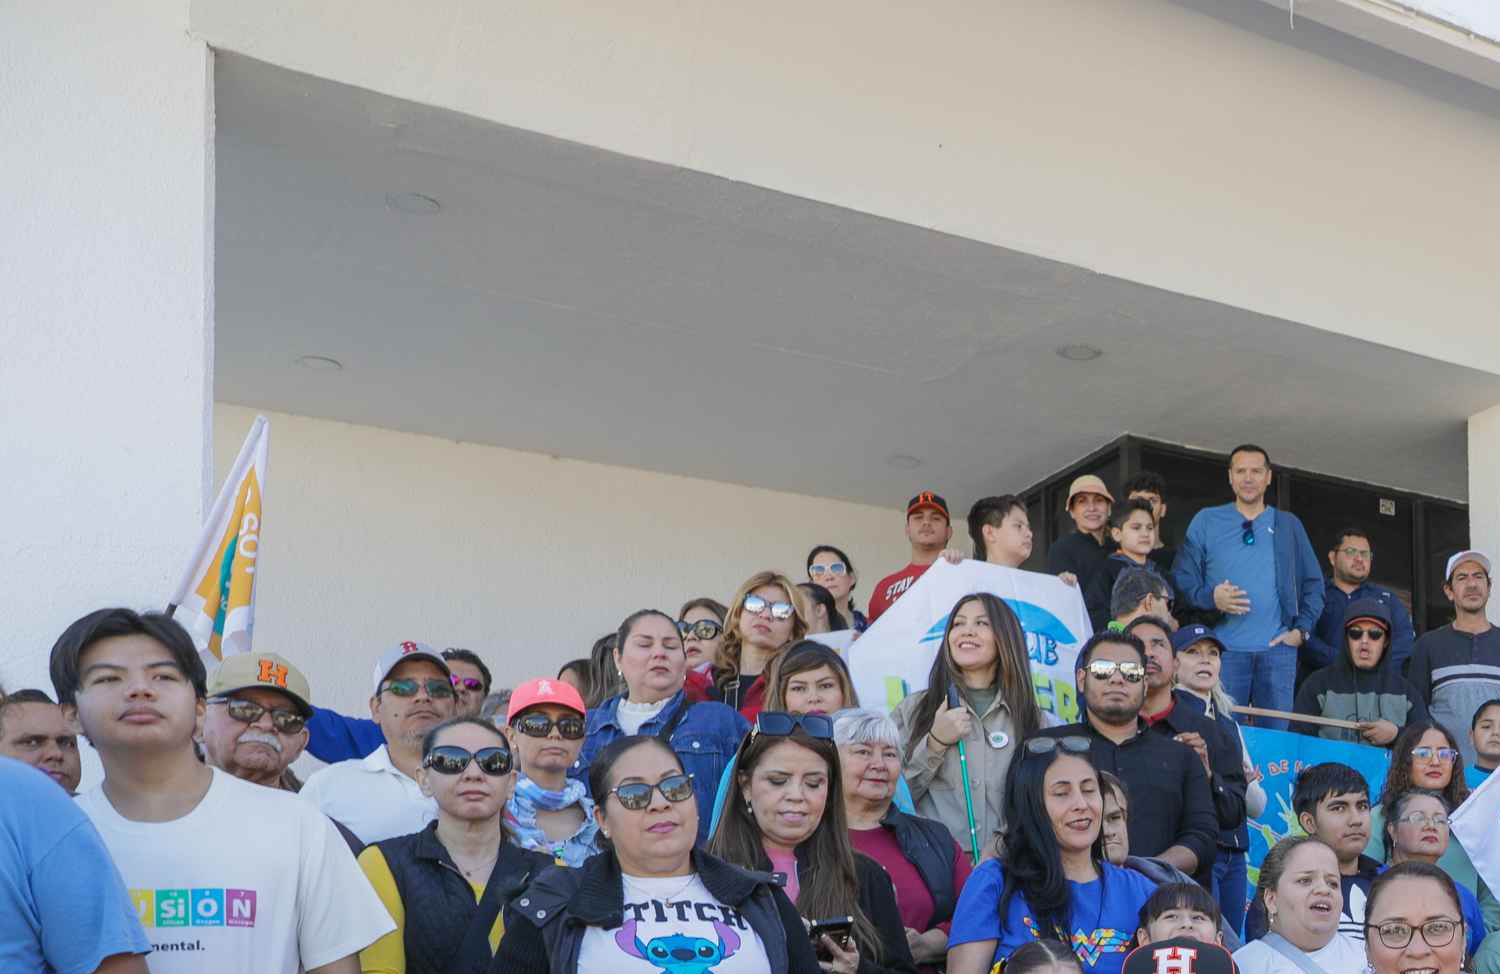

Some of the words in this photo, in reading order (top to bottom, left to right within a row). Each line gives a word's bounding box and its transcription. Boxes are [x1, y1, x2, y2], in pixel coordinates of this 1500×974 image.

[257, 658, 288, 689] H
[1267, 759, 1290, 776] DE
[624, 899, 748, 930] TITCH
[151, 940, 206, 952] mental.
